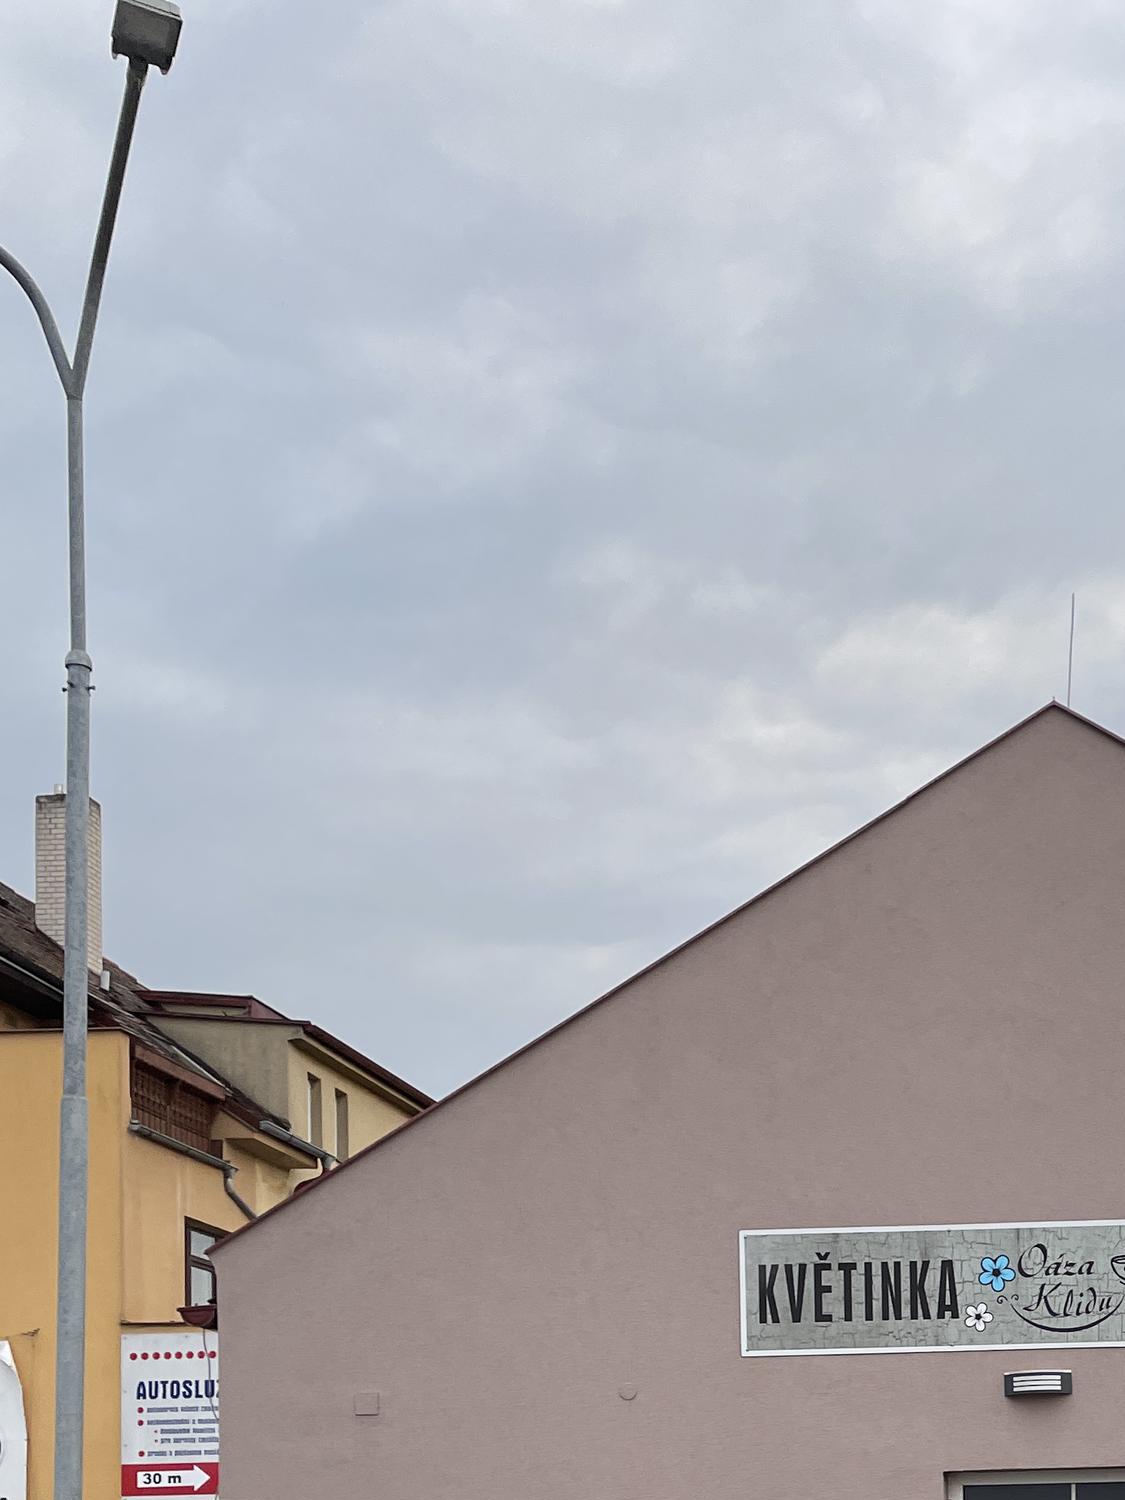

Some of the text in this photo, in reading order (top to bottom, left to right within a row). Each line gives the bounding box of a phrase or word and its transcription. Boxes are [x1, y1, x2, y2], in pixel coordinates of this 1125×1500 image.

[1017, 1243, 1095, 1277] Oáza
[758, 1251, 960, 1324] KVĚTINKA
[1024, 1282, 1115, 1318] Klidu
[143, 1473, 182, 1484] 30 m
